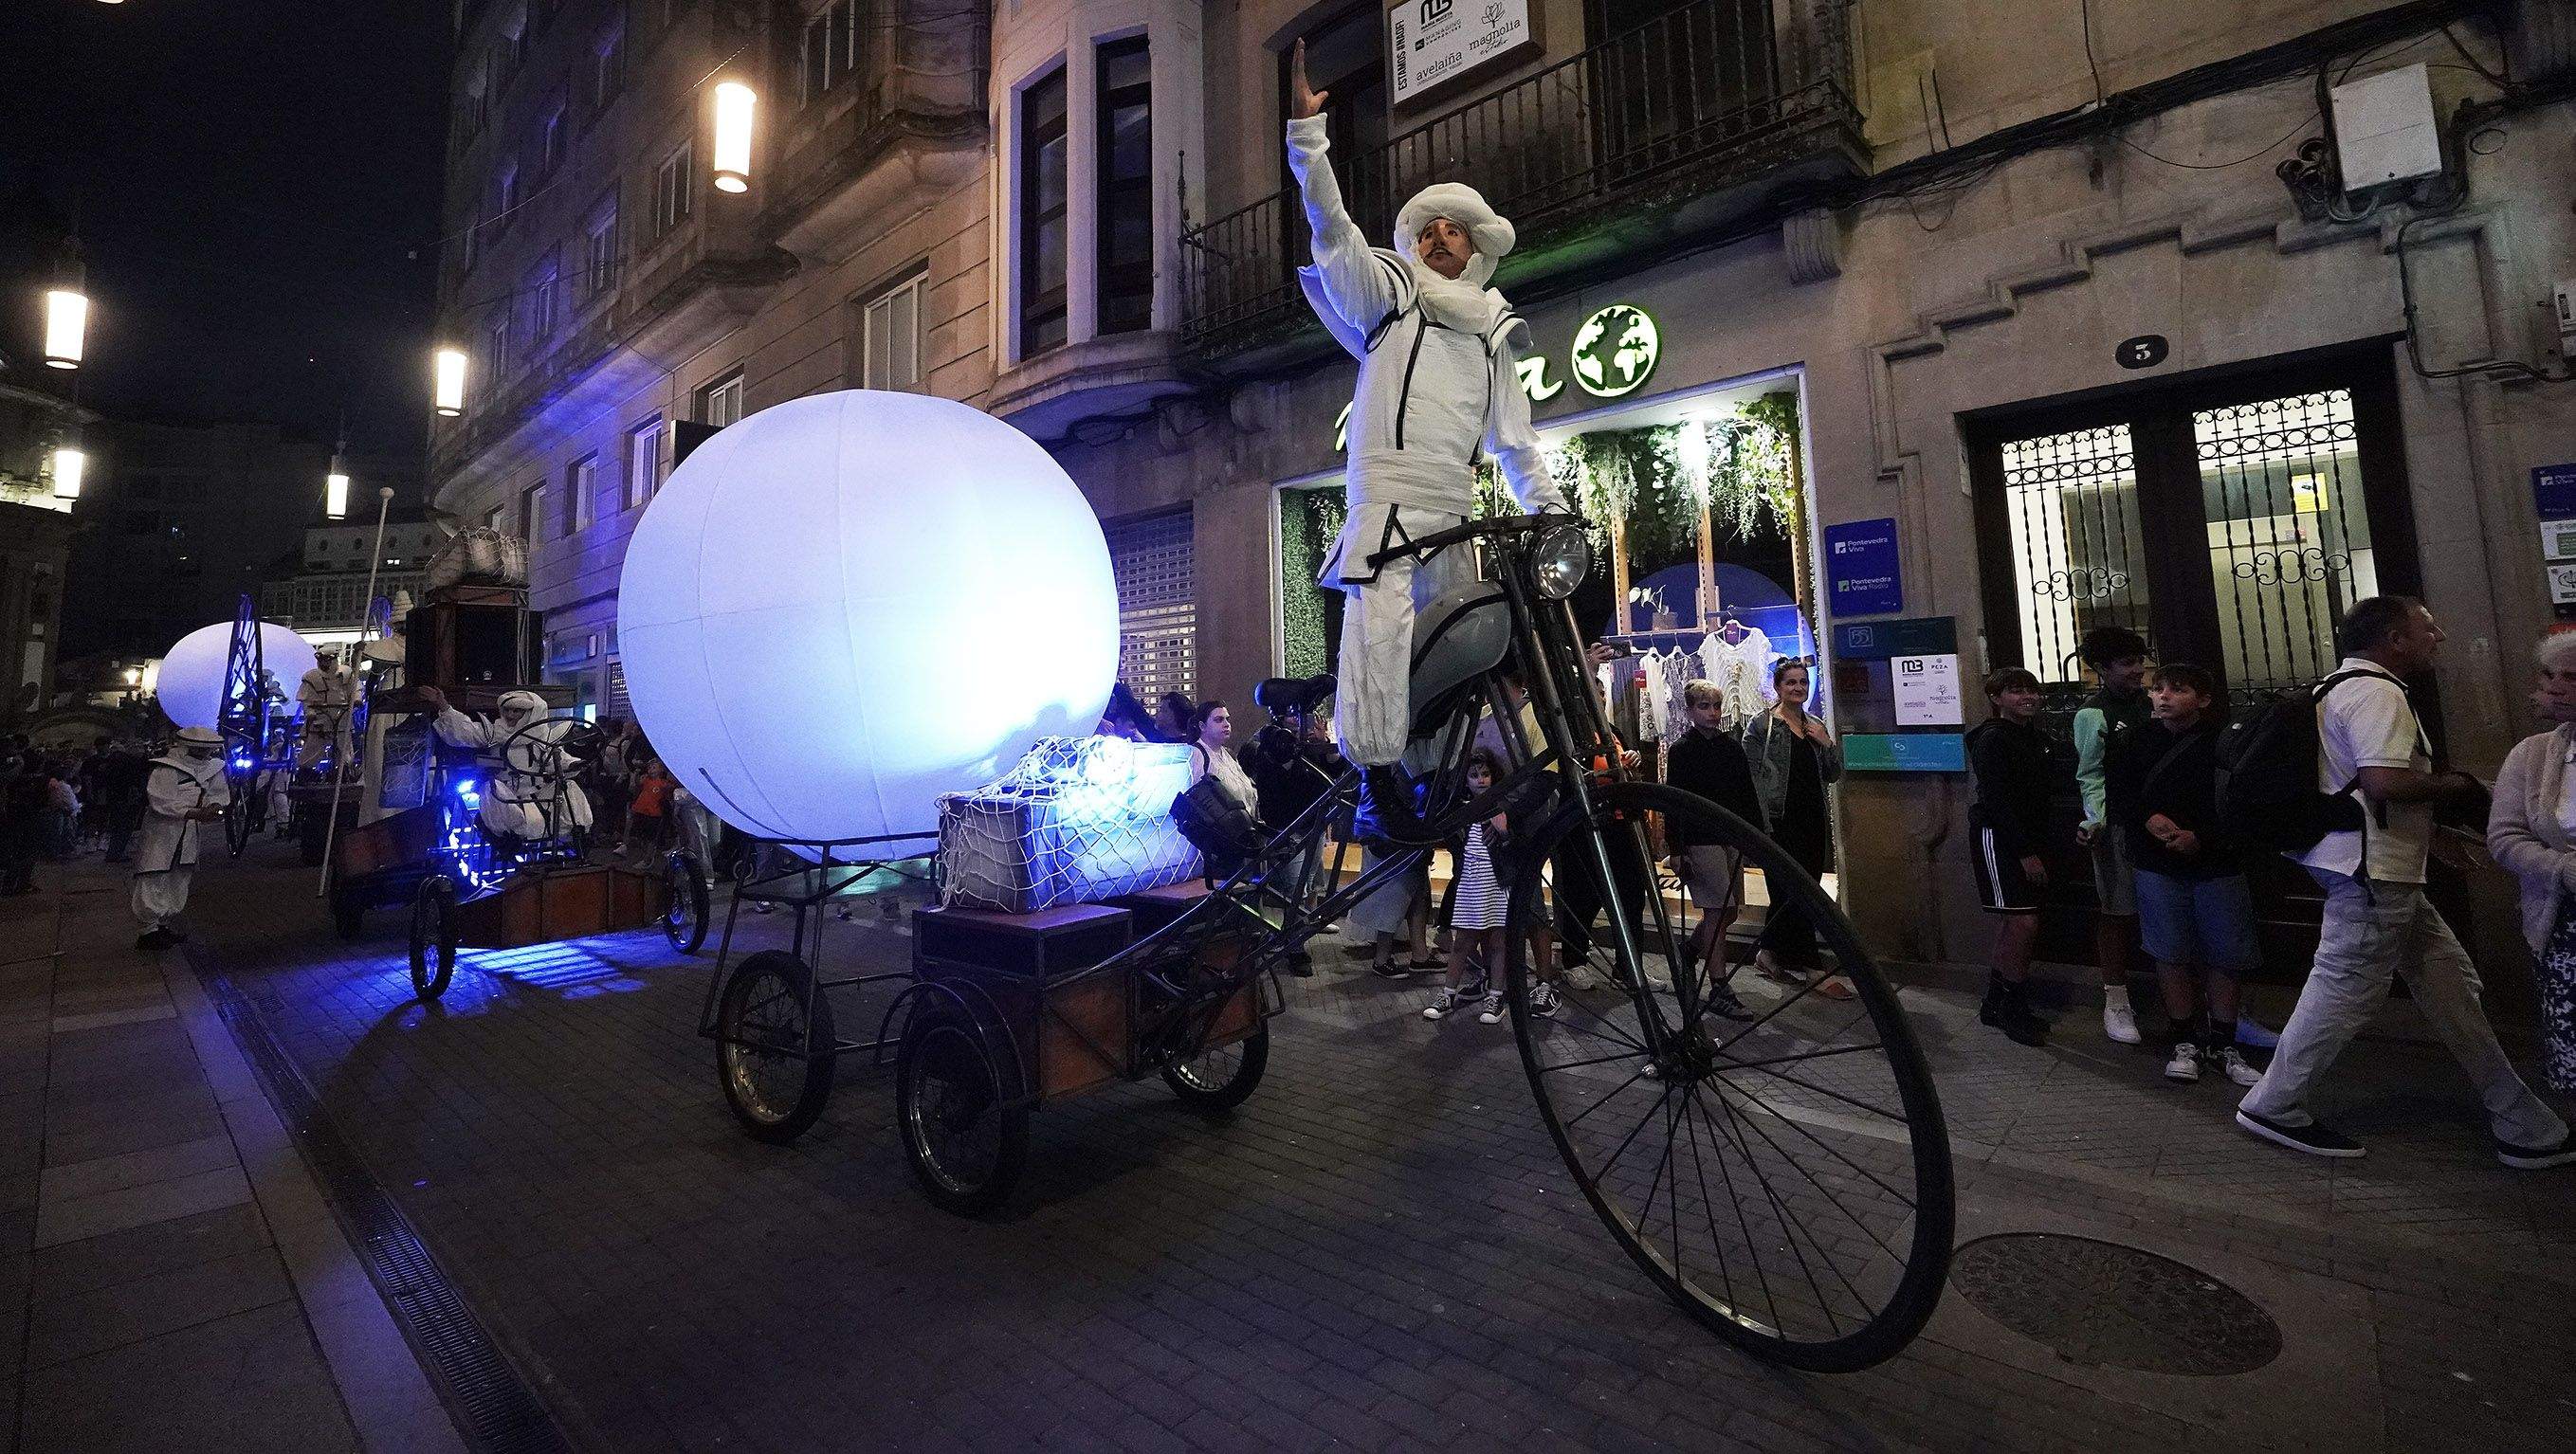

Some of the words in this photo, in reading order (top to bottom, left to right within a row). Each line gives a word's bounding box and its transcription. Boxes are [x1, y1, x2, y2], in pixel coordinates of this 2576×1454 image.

[1469, 19, 1521, 51] magnolia
[1397, 50, 1408, 92] ESTAMOS
[1416, 50, 1462, 82] avelaiña
[2135, 342, 2151, 360] 3
[1847, 537, 1889, 547] Pontevedra
[1851, 576, 1891, 586] Pontevedra
